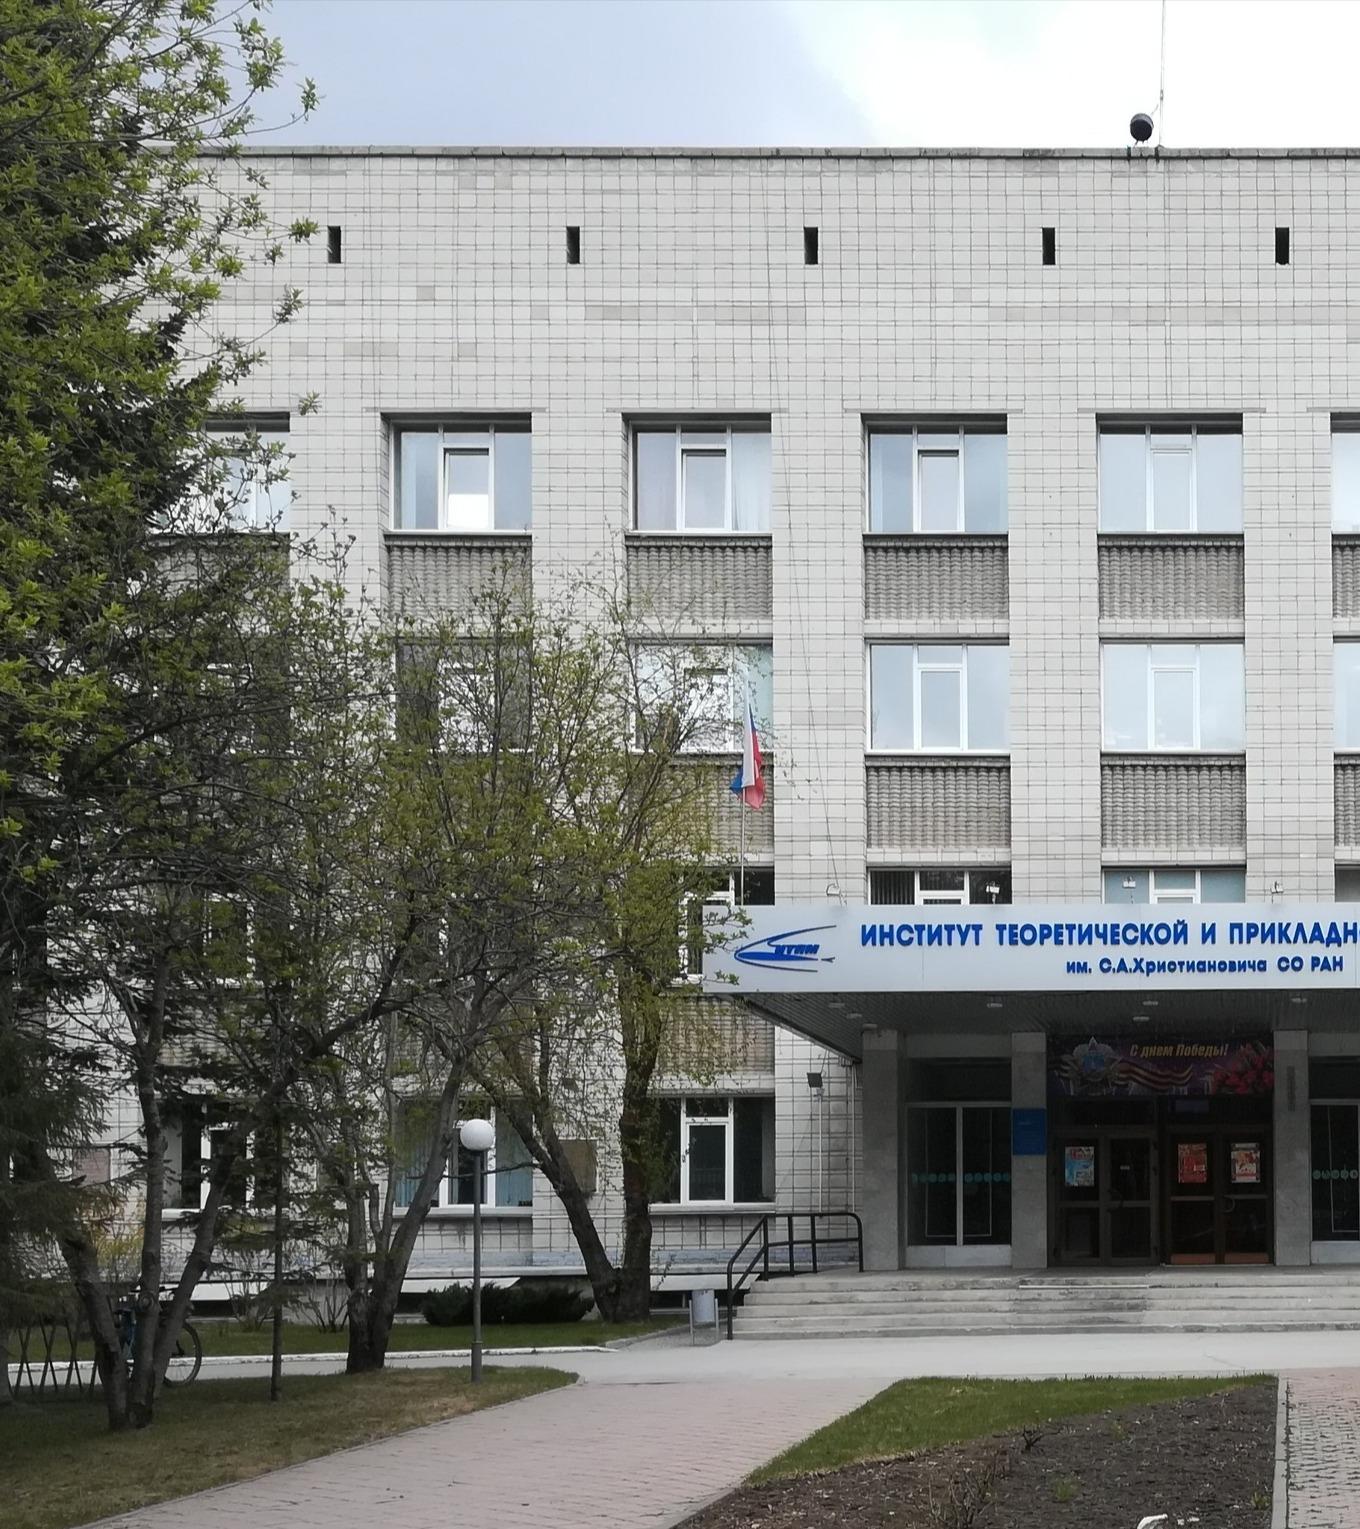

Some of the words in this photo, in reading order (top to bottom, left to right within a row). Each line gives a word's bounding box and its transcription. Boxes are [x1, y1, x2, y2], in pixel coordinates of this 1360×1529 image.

[860, 921, 983, 946] ИНСТИТУТ
[995, 919, 1189, 946] ТЕОРЕТИЧЕСКОЙ
[1201, 922, 1217, 945] И
[1065, 960, 1092, 974] им.
[1277, 956, 1304, 972] СО
[1310, 956, 1344, 972] РАН
[1130, 1043, 1139, 1056] С
[1175, 1043, 1229, 1057] Победы!
